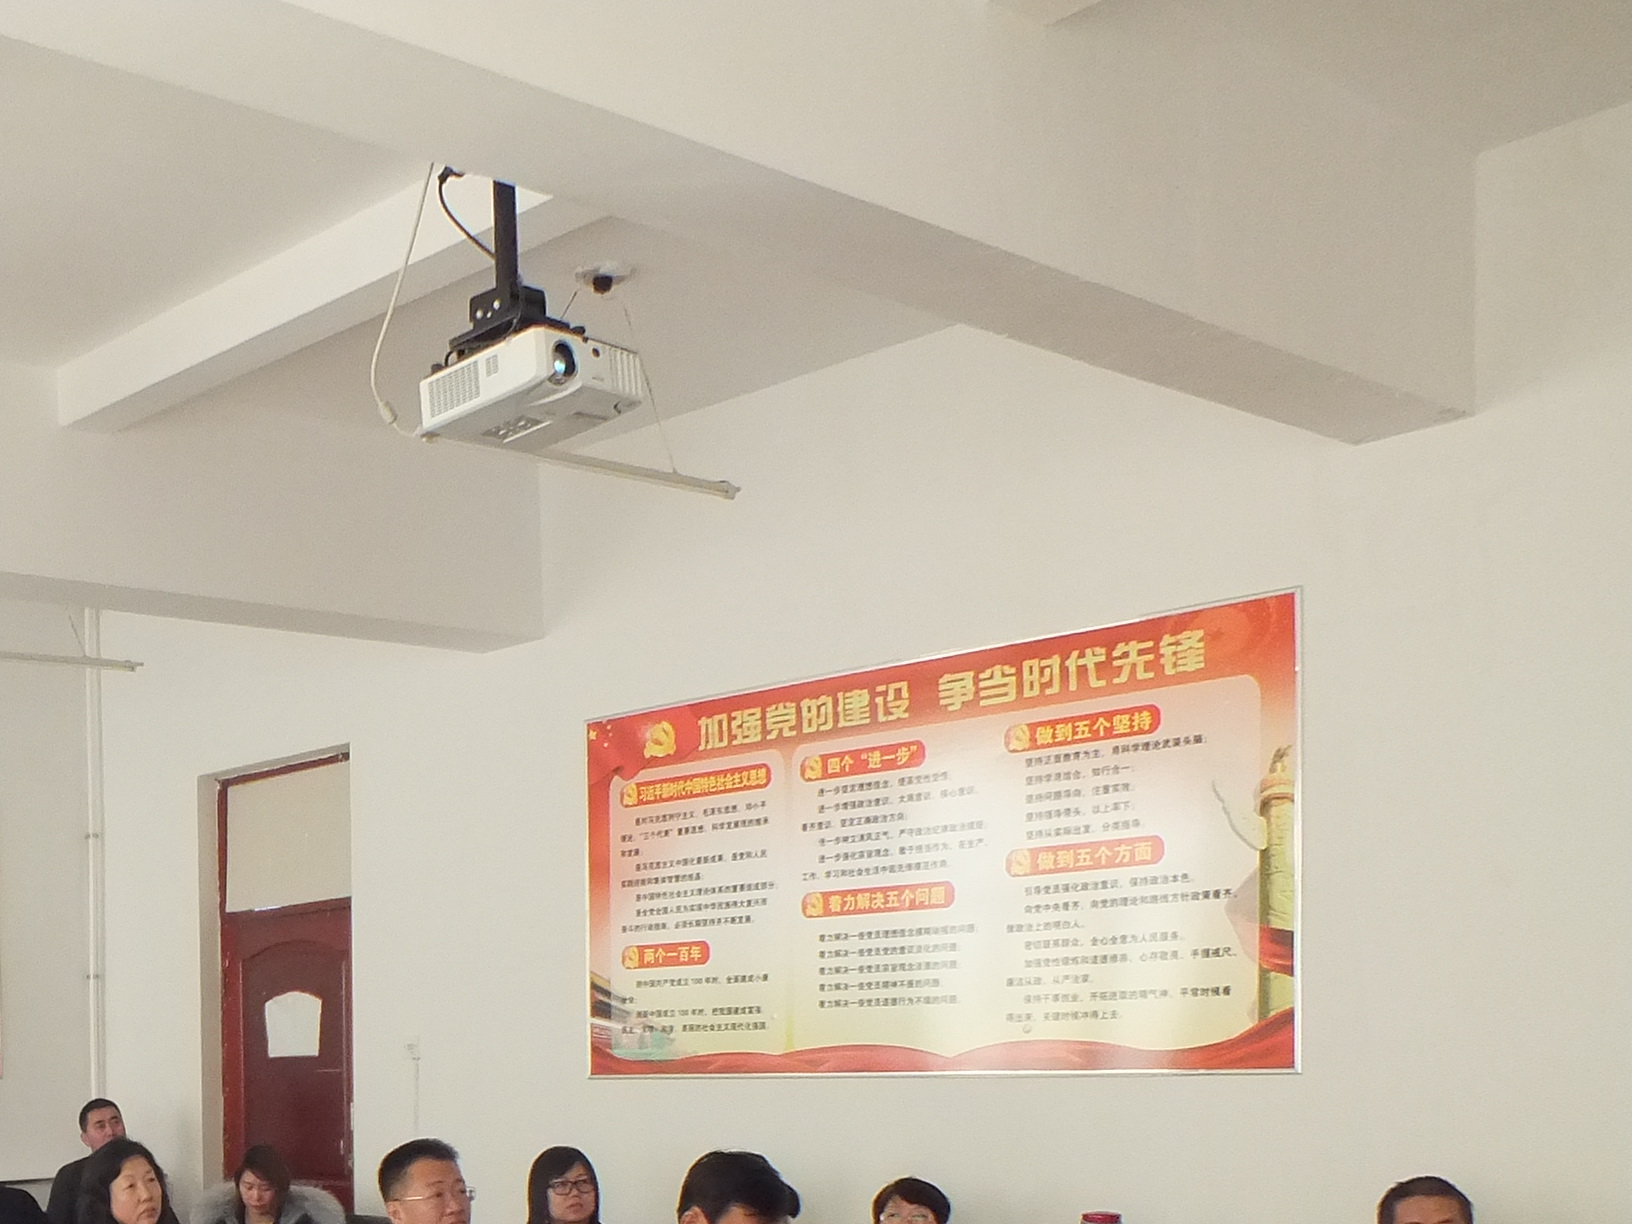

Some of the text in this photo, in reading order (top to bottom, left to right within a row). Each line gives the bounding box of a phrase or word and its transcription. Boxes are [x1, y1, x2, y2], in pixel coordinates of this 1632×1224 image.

[696, 628, 1207, 751] 加强党的建设 争当时代先锋
[1035, 710, 1153, 745] 做到五个坚持
[638, 770, 767, 802] 习近平新时代中国特色社会主义思想
[1036, 841, 1153, 870] 做到五个方面
[828, 885, 946, 913] 着力解决五个问题
[643, 945, 702, 964] 两个一百年
